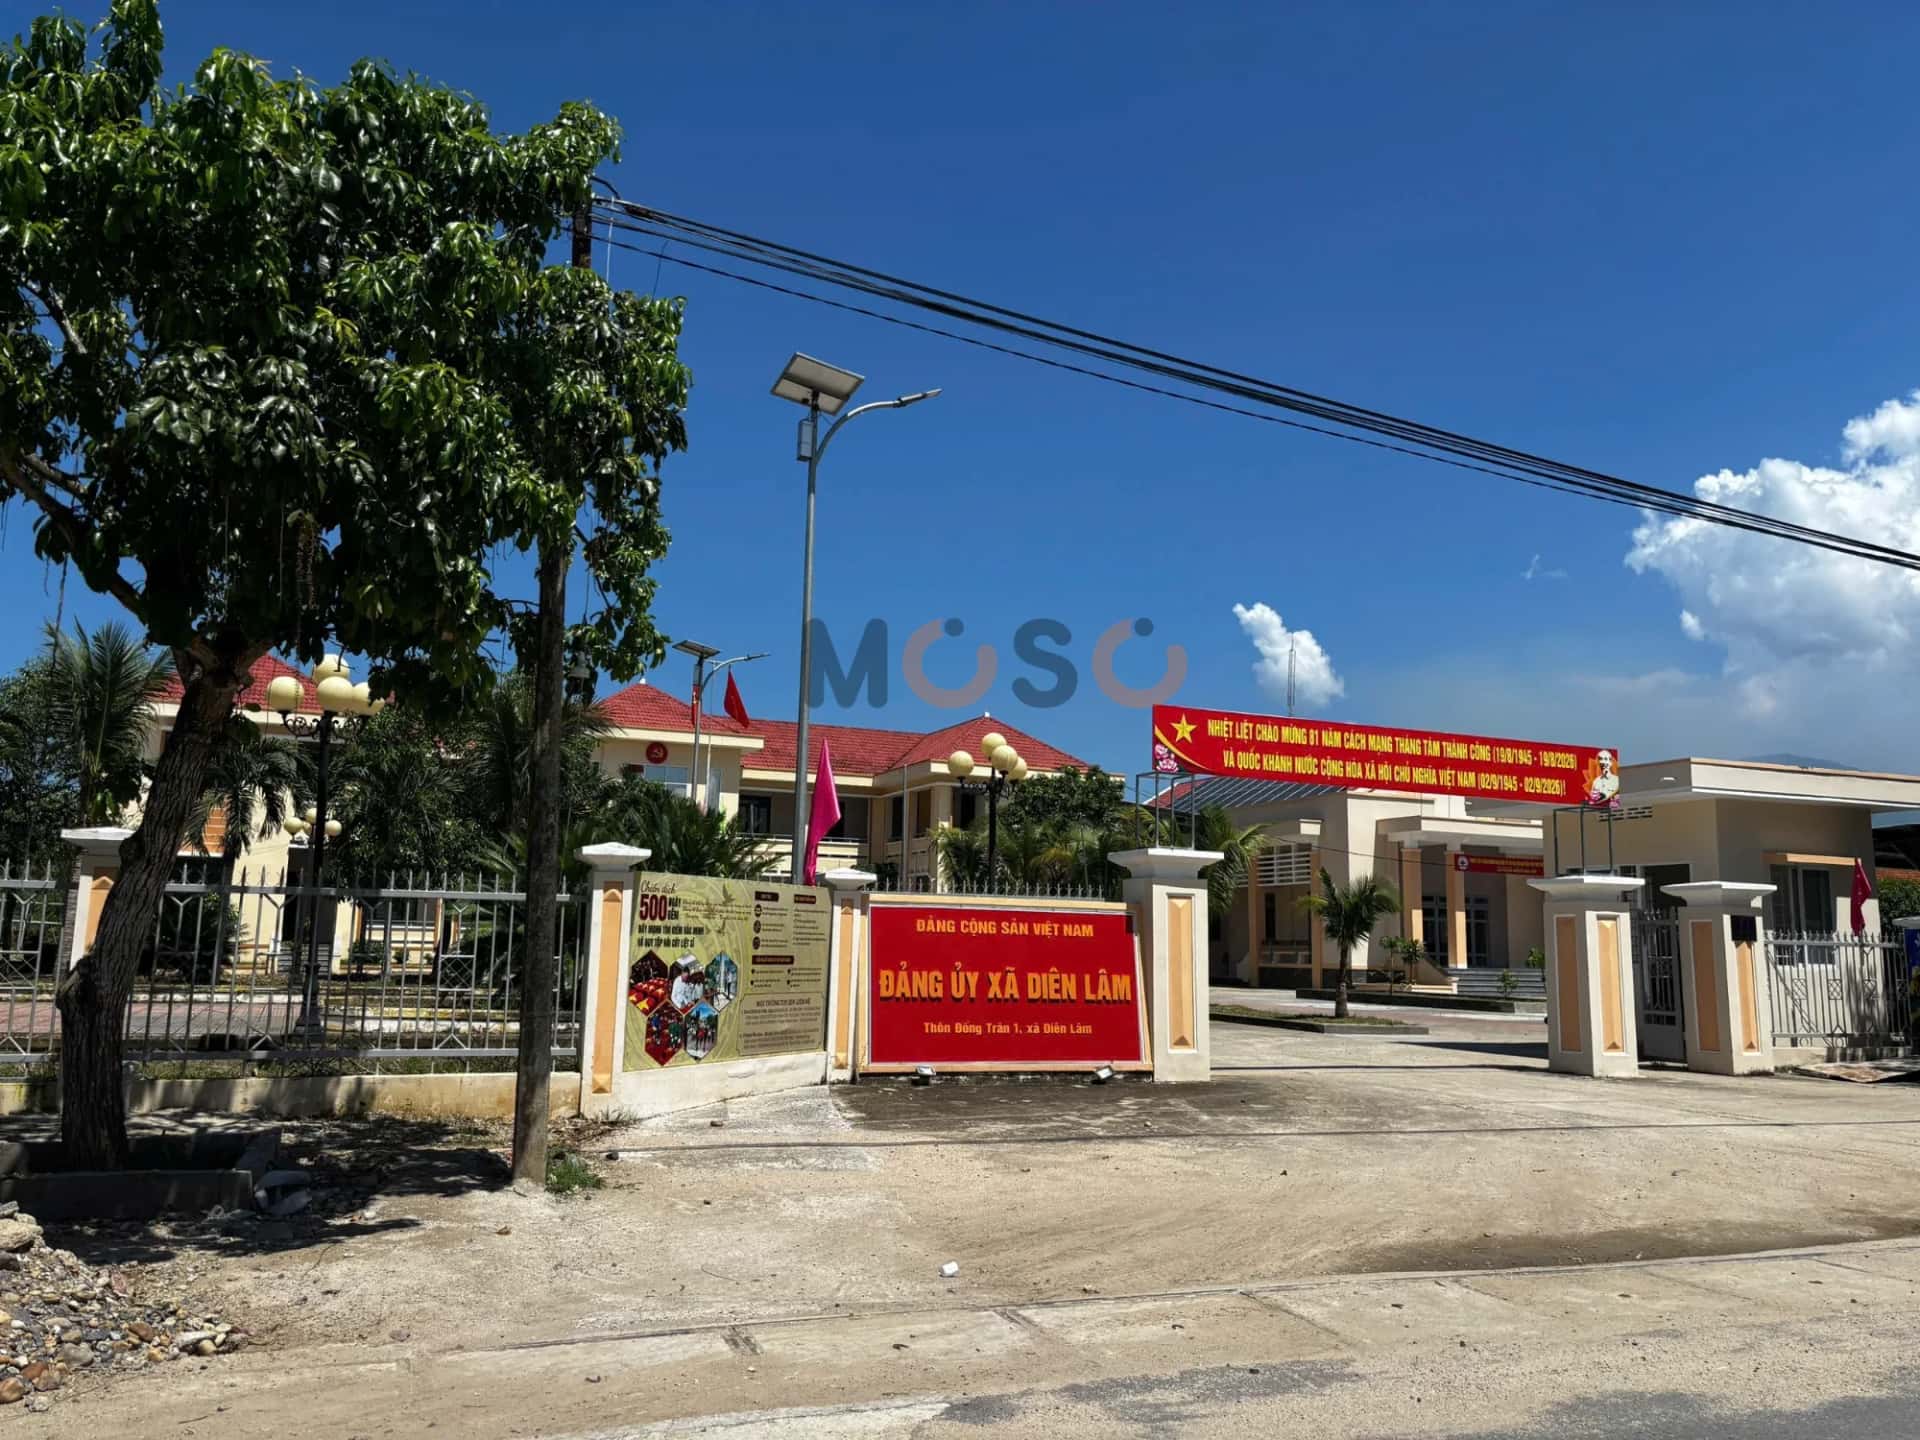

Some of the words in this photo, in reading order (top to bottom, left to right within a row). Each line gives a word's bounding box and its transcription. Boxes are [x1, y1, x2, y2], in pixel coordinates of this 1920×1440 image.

[1208, 717, 1234, 742] NHIỆT
[1236, 719, 1253, 743] LIỆT
[1256, 720, 1279, 743] CHÀO
[1282, 723, 1307, 745] MỪNG
[1309, 728, 1319, 746] 81
[1322, 727, 1341, 748] NĂM
[1344, 730, 1366, 751] CÁCH
[1368, 733, 1392, 755] MẠNG
[1395, 734, 1421, 755] THÁNG
[1423, 737, 1440, 757] TÁM
[1442, 740, 1468, 759] THÀNH
[1470, 741, 1491, 761] CÔNG
[1223, 747, 1235, 768] VÀ
[1237, 746, 1260, 770] QUỐC
[1263, 752, 1292, 773] KHÁNH
[1295, 754, 1318, 775] NƯỚC
[1320, 756, 1343, 780] CỘNG
[1365, 760, 1376, 780] XÃ
[1378, 761, 1392, 784] HỘI
[1394, 761, 1410, 783] CHỦ
[1412, 765, 1437, 785] NGHĨA
[1439, 766, 1455, 790] VIỆT
[1457, 770, 1476, 788] NAM
[640, 894, 667, 921] 500
[916, 915, 956, 932] ĐẢNG
[960, 917, 997, 936] CỘNG
[1001, 918, 1028, 935] SẢN
[1033, 921, 1060, 938] VIỆT
[1063, 924, 1094, 937] NAM
[879, 961, 943, 998] ĐẢNG
[951, 962, 979, 999] ỦY
[988, 966, 1019, 999] XÃ
[1027, 966, 1077, 1000] DIÊN
[1084, 968, 1132, 1001] LÂM
[924, 1022, 950, 1033] Thôn
[1027, 1022, 1040, 1033] xã
[1043, 1022, 1067, 1034] Diên
[1070, 1022, 1092, 1034] Lâm
